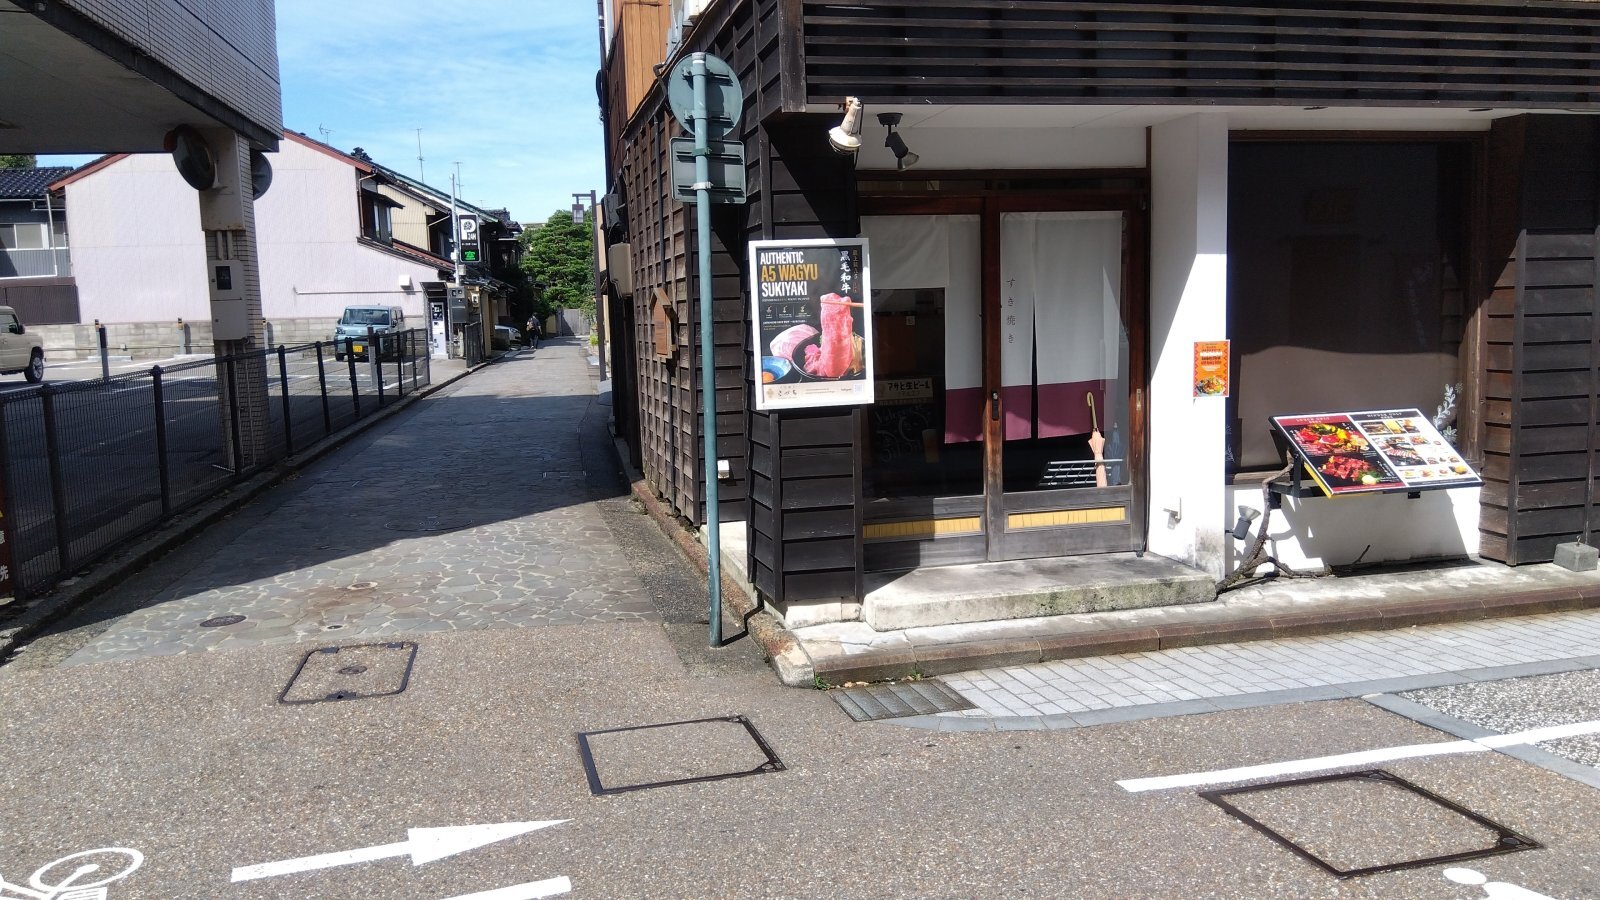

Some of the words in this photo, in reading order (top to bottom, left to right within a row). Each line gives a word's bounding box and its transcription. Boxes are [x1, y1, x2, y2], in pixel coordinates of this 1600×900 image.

[461, 219, 476, 240] P
[760, 251, 804, 265] AUTHENTIC
[761, 265, 777, 281] A5
[778, 264, 818, 281] WAGYU
[840, 250, 851, 294] 黒毛和牛
[761, 281, 808, 297] SUKIYAKI
[1005, 277, 1016, 344] すき焼き
